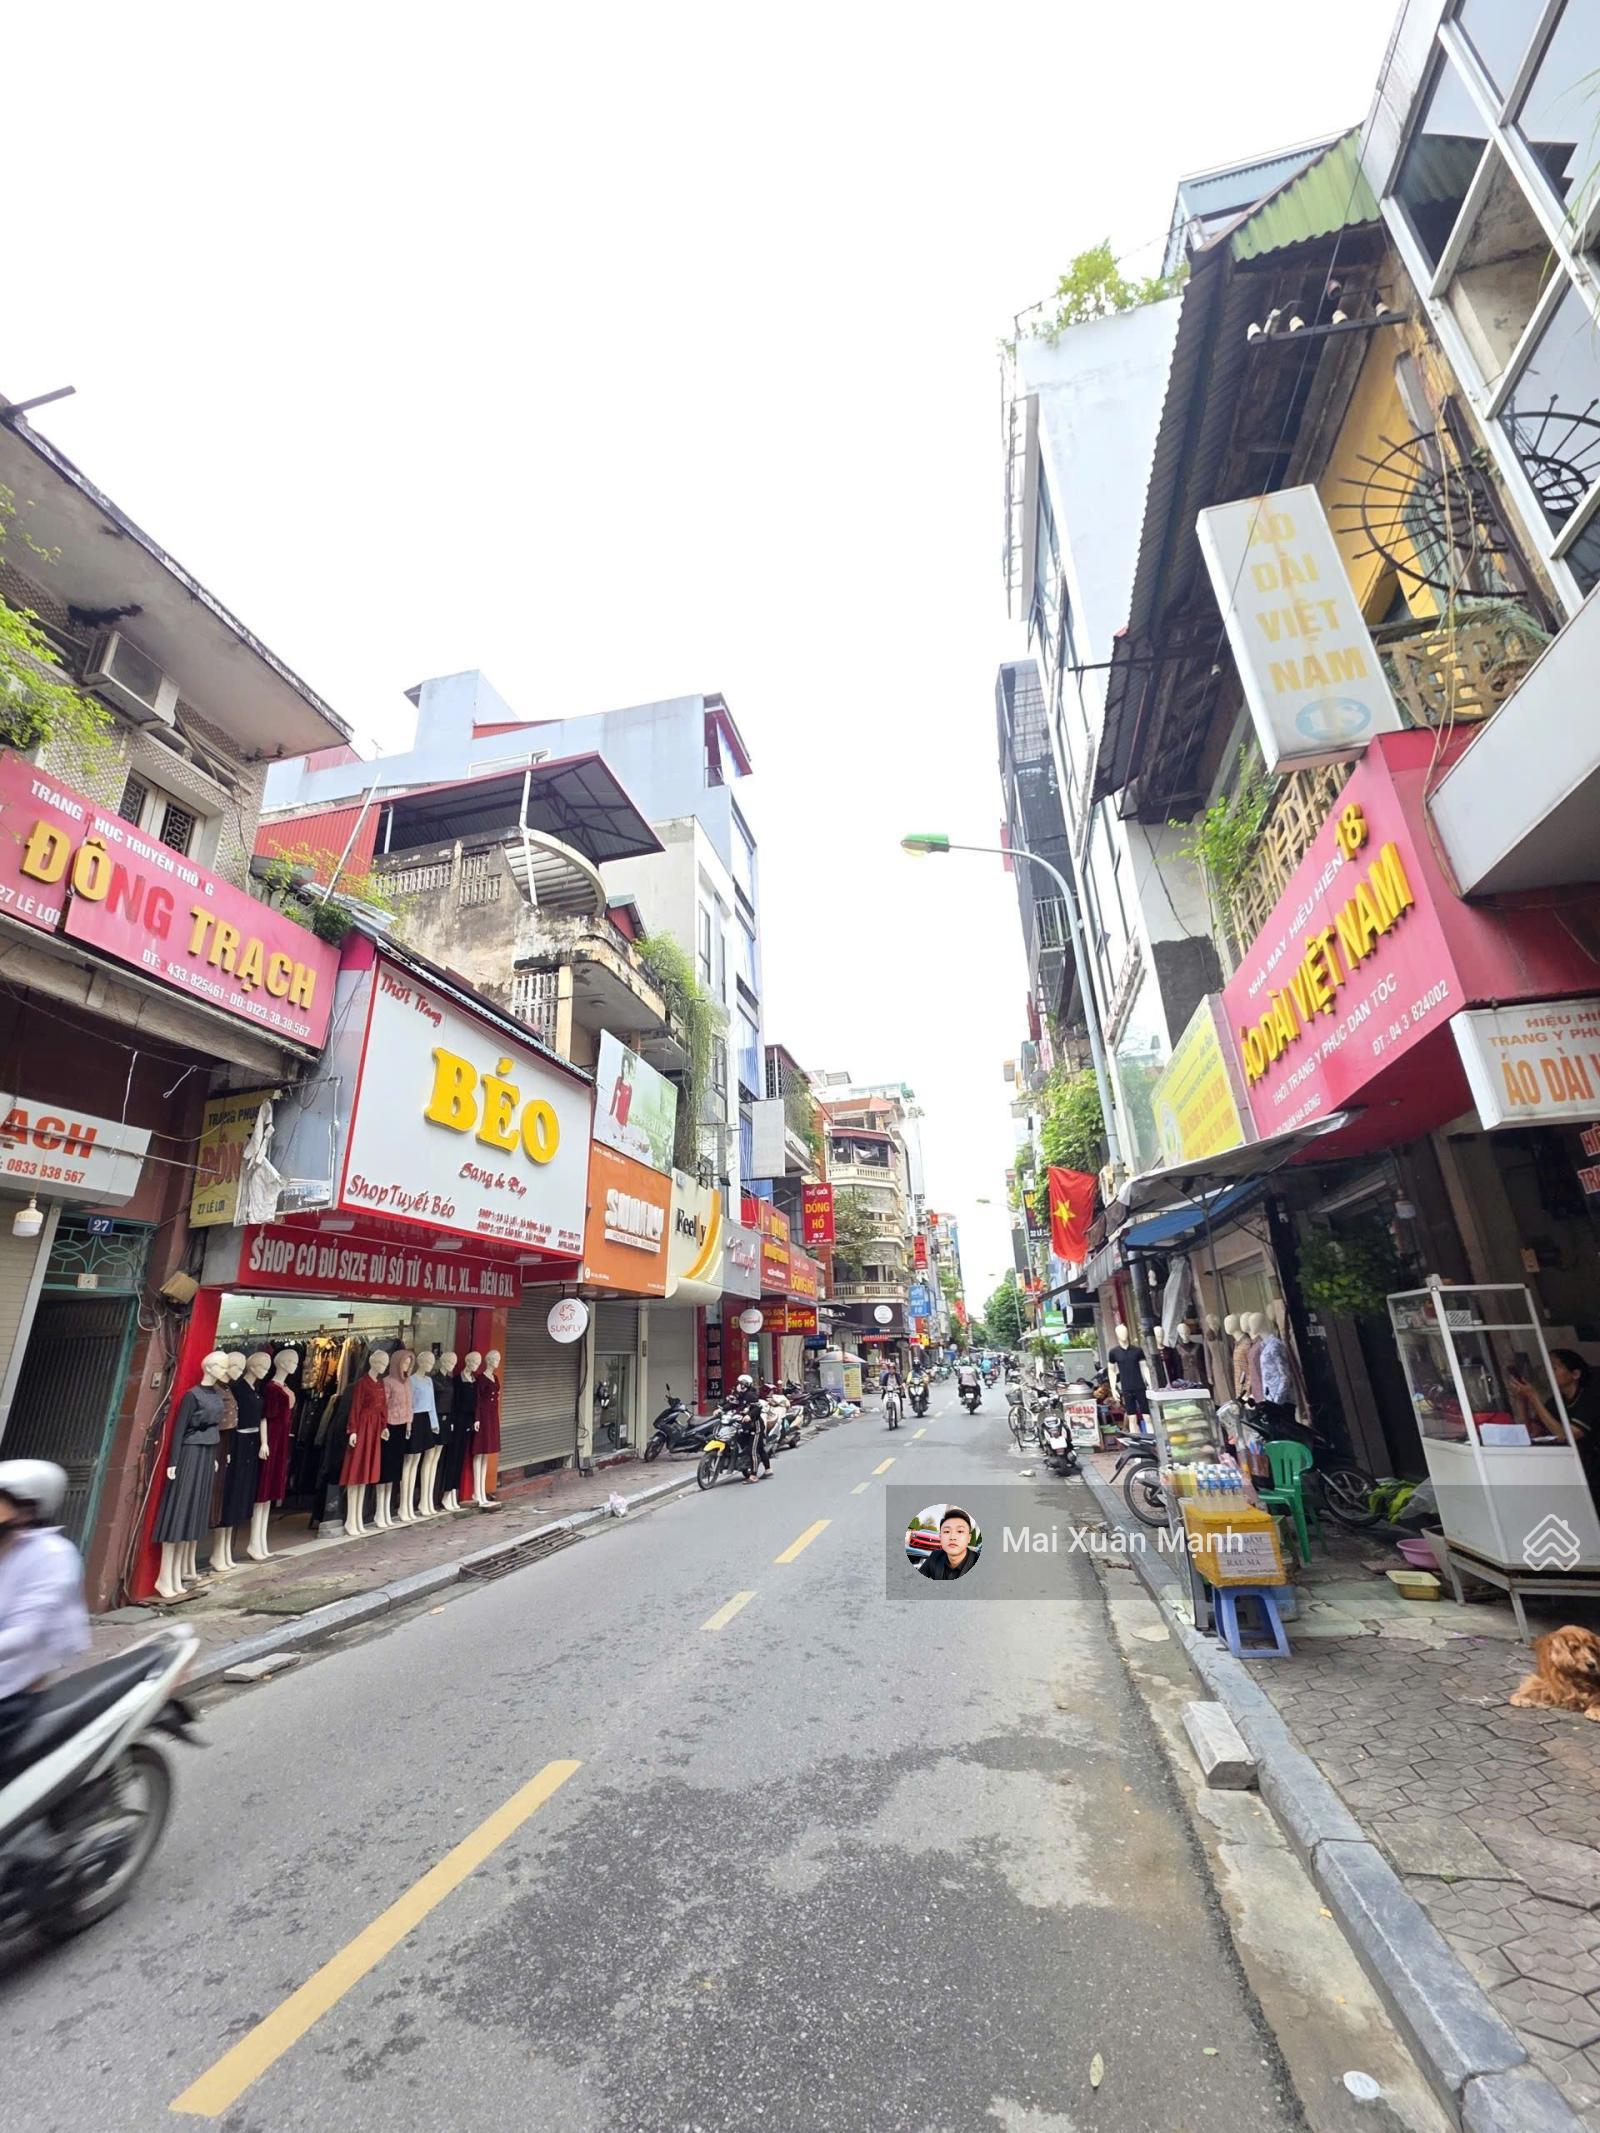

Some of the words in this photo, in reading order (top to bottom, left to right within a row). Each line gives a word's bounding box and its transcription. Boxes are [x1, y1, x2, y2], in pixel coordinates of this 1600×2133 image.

[1252, 550, 1320, 592] DÀI
[1256, 597, 1340, 643] VIỆT
[1268, 646, 1368, 695] NAM
[31, 779, 83, 822] TRANG
[1335, 803, 1368, 861] 18
[16, 894, 35, 915] LÊ
[35, 903, 61, 926] LỢI
[187, 904, 317, 1010] TRẠCH
[1238, 1025, 1266, 1089] ÁO
[1259, 988, 1301, 1062] DÀI
[1288, 925, 1345, 1022] VIỆT
[1335, 841, 1414, 970] NAM
[1248, 970, 1268, 999] NHÀ
[1267, 936, 1287, 972] MAY
[1289, 899, 1314, 940] HIỆU
[1287, 1057, 1315, 1089] TRANG
[1313, 1050, 1322, 1065] Y
[1346, 1001, 1371, 1033] DÂN
[1369, 972, 1398, 1010] TỘC
[1401, 1014, 1410, 1030] 3
[1488, 1031, 1548, 1048] TRANG
[1551, 1029, 1564, 1041] Y
[1500, 1052, 1541, 1106] ÁO
[1539, 1047, 1596, 1103] DÀI
[424, 1047, 560, 1165] BÉO
[7, 1158, 38, 1176] 0833
[40, 1165, 62, 1180] 838
[64, 1169, 86, 1184] 567
[347, 1174, 389, 1207] Shop
[390, 1184, 430, 1213] Tuyết
[431, 1197, 455, 1219] Béo
[91, 1219, 110, 1233] 27
[250, 1236, 294, 1274] SHOP
[295, 1238, 316, 1277] CÓ
[318, 1238, 338, 1280] ĐỦ
[339, 1248, 366, 1283] SIZE
[369, 1246, 386, 1284] ĐỦ
[406, 1254, 422, 1286] TỪ
[480, 1262, 497, 1296] ĐẾN
